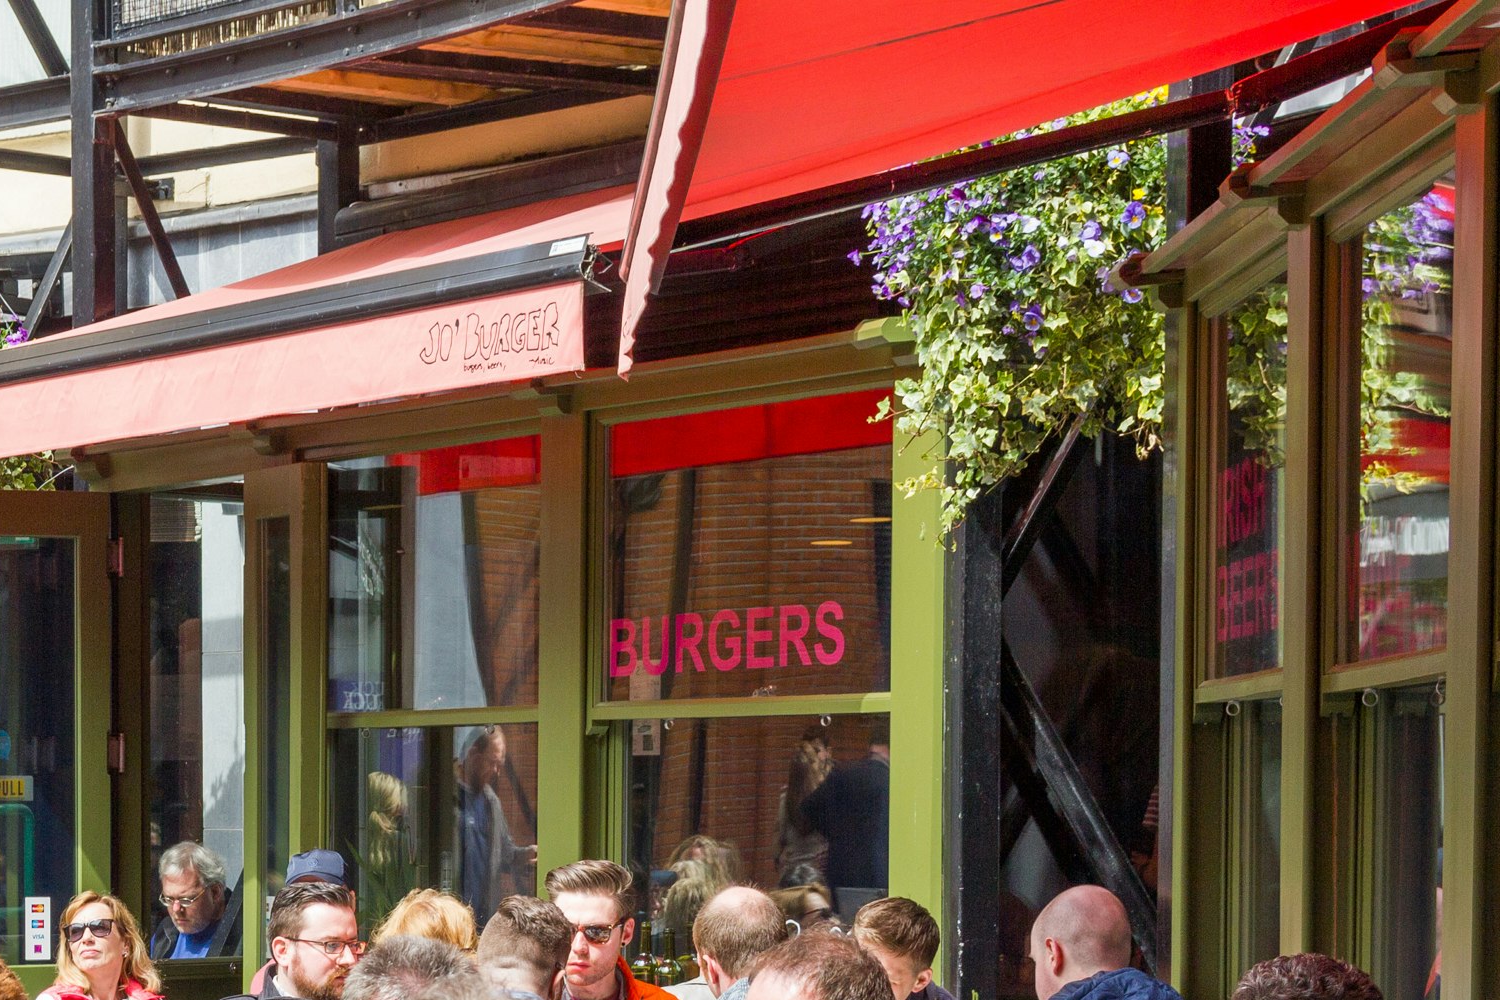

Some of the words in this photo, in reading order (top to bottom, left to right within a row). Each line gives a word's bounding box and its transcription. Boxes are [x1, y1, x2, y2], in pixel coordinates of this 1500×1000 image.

[419, 318, 459, 364] JO'
[464, 302, 559, 360] BURGER
[609, 600, 846, 678] BURGERS
